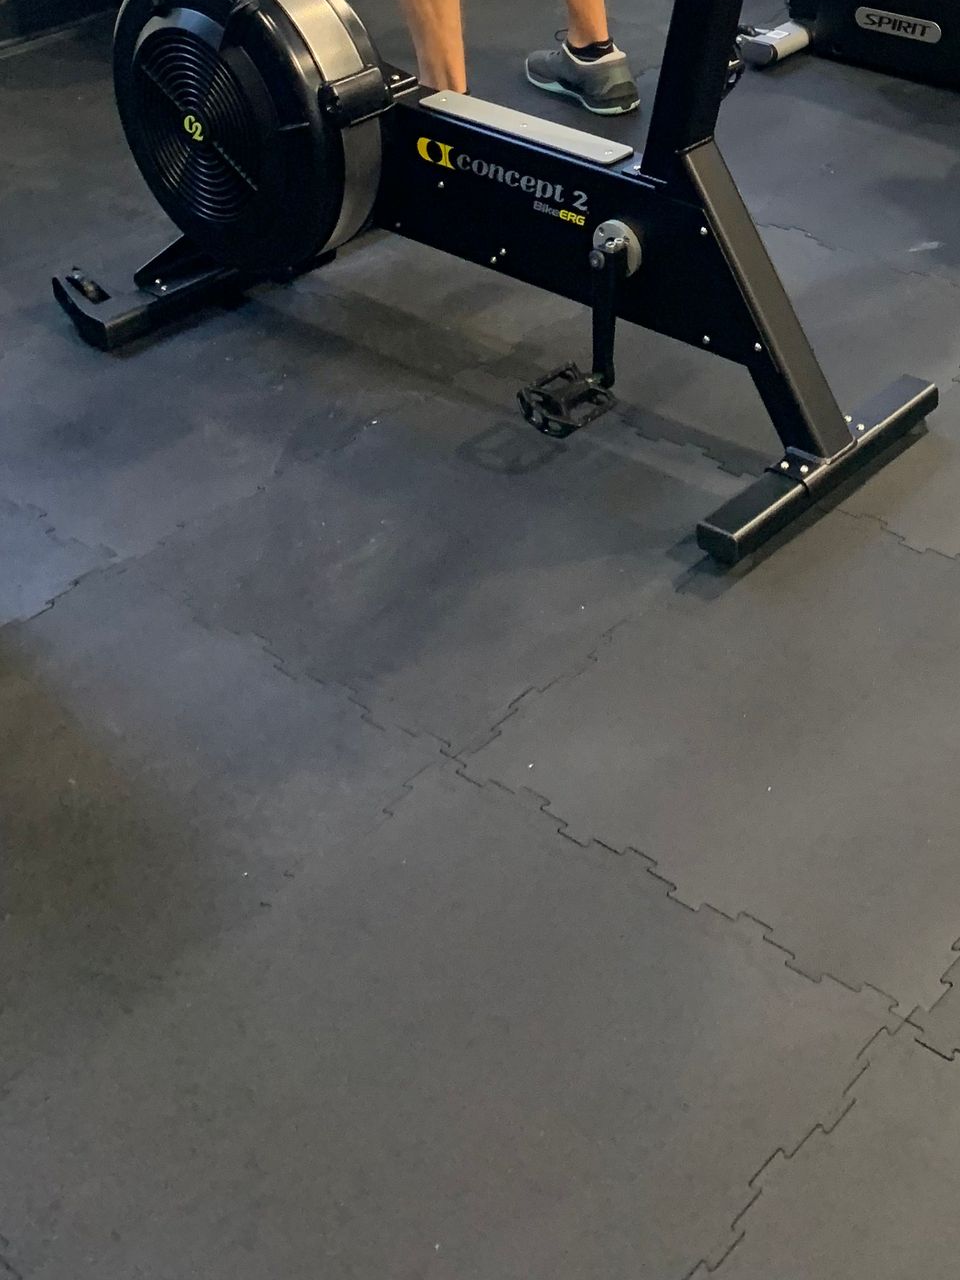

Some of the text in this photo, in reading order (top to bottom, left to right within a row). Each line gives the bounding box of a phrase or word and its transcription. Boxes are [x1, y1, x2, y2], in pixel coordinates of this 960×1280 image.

[863, 13, 930, 37] SPIRIT
[184, 115, 204, 141] C2
[457, 153, 589, 211] concept 2
